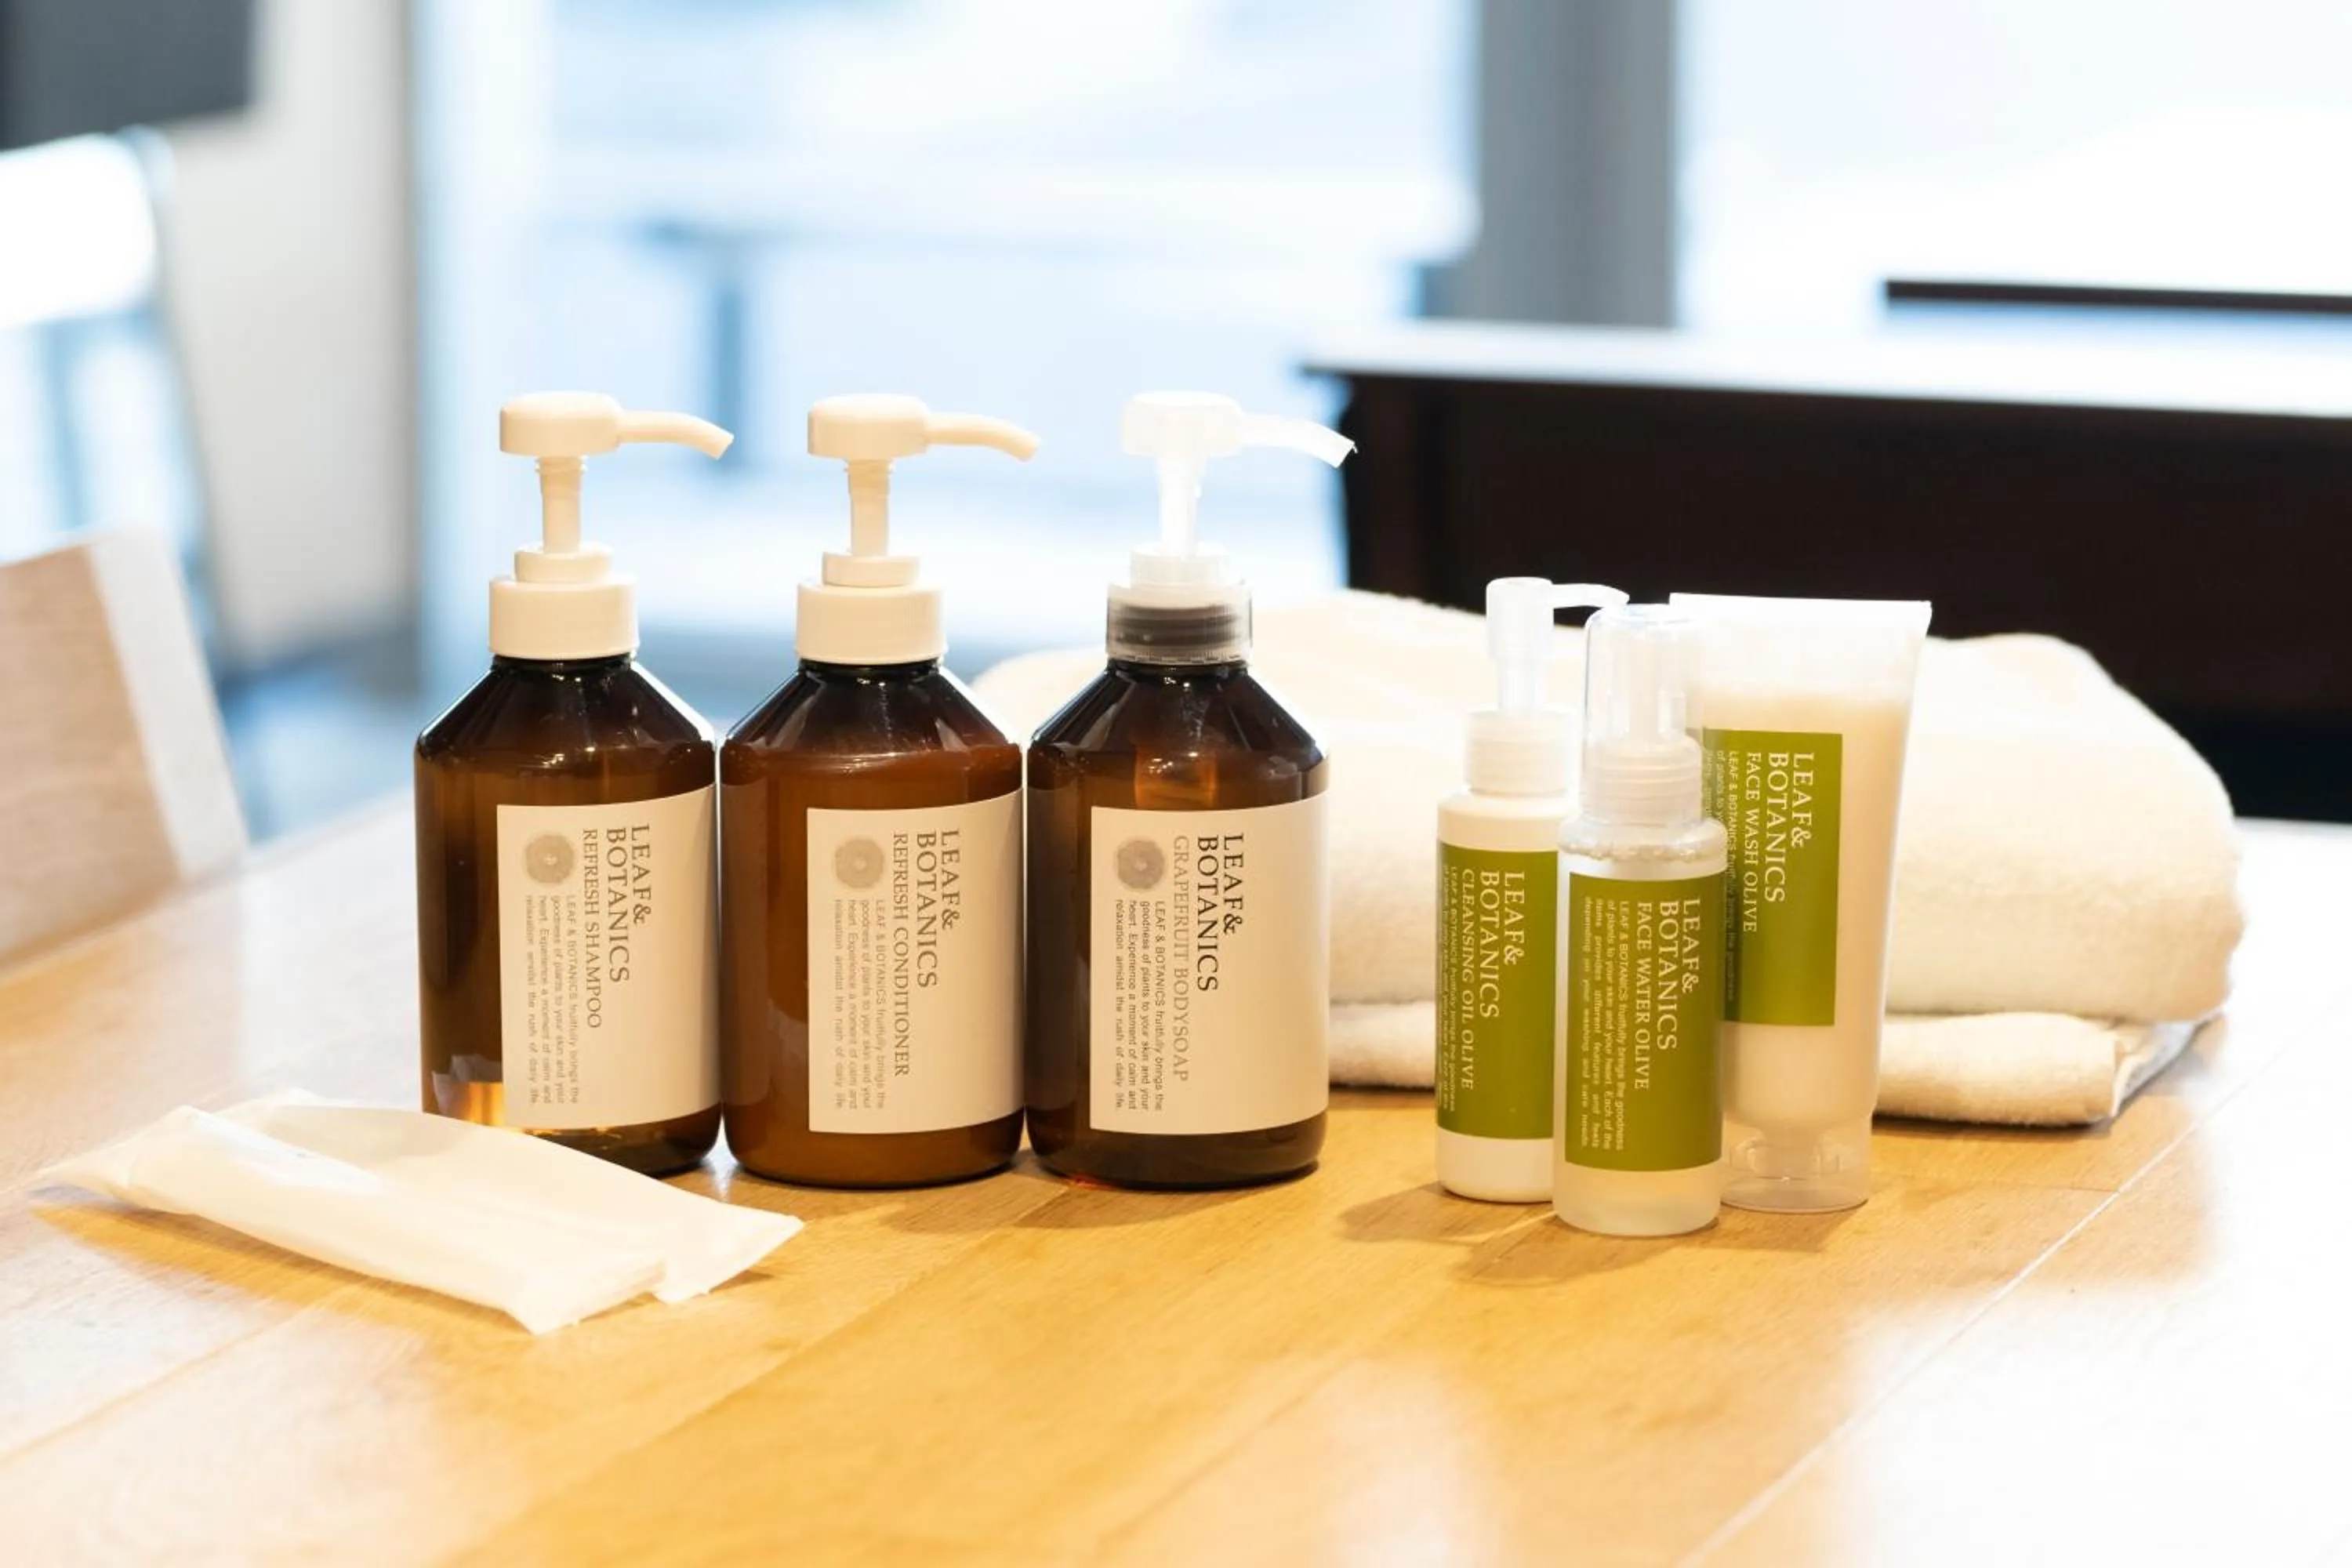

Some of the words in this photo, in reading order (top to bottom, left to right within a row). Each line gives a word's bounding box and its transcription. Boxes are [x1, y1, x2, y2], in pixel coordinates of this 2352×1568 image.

[1729, 751, 1739, 779] LEAF
[1746, 753, 1761, 800] FACE
[1728, 793, 1737, 850] BOTANICS
[1765, 753, 1789, 902] BOTANICS
[1791, 753, 1814, 848] LEAF&
[1744, 808, 1759, 866] WASH
[583, 829, 599, 915] REFRESH
[632, 825, 651, 924] LEAF&
[894, 833, 909, 920] REFRESH
[941, 829, 960, 930] LEAF&
[1174, 836, 1189, 961] GRAPEFRUIT
[1223, 834, 1243, 935] LEAF&
[1744, 872, 1758, 931] OLIVE
[607, 827, 630, 982] BOTANICS
[916, 831, 938, 988] BOTANICS
[1153, 901, 1166, 930] LEAF
[1198, 836, 1218, 991] BOTANICS
[1462, 869, 1475, 982] CLEANSING
[1504, 873, 1524, 964] LEAF&
[1620, 901, 1629, 928] LEAF
[1637, 902, 1652, 950] FACE
[585, 922, 601, 1028] SHAMPOO
[1142, 953, 1151, 964] of
[1480, 872, 1499, 1018] BOTANICS
[1618, 944, 1628, 1000] BOTANICS
[1657, 902, 1679, 1049] BOTANICS
[1682, 898, 1700, 993] LEAF&
[894, 927, 909, 1076] CONDITIONER
[1116, 996, 1124, 1012] the
[1142, 1002, 1150, 1011] to
[1155, 947, 1165, 1007] BOTANICS
[1462, 989, 1474, 1023] OIL
[1635, 958, 1651, 1023] WATER
[1116, 1047, 1124, 1058] of
[1129, 1049, 1138, 1058] of
[1173, 968, 1189, 1081] BODYSOAP
[1142, 1066, 1151, 1083] and
[1461, 1029, 1474, 1090] OLIVE
[1635, 1029, 1650, 1088] OLIVE
[1128, 1091, 1138, 1109] and
[1155, 1094, 1164, 1110] the
